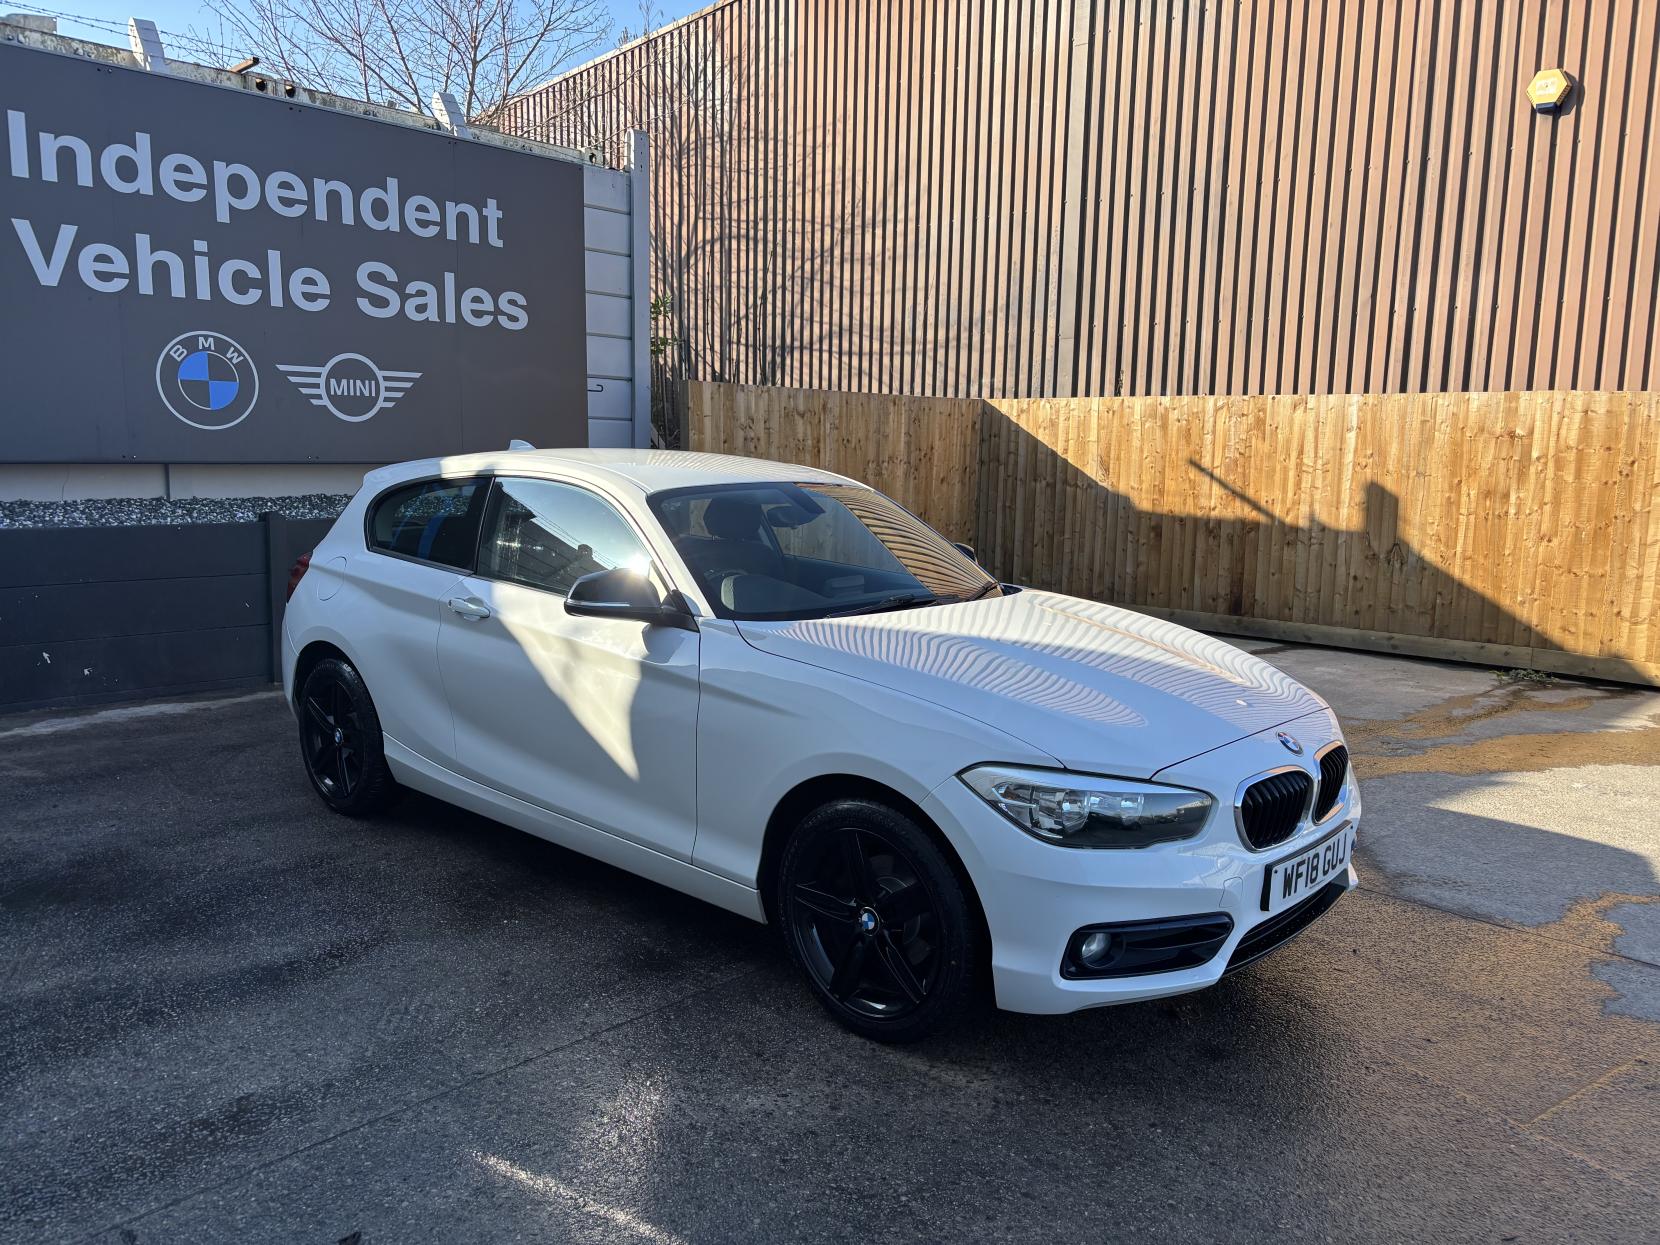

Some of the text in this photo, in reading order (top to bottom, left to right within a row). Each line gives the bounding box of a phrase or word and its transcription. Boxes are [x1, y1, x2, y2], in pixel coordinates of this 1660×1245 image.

[7, 109, 504, 248] Independent
[10, 217, 529, 331] Vehicle Sales
[169, 336, 243, 365] BMW
[329, 377, 377, 398] MINI
[1282, 833, 1347, 899] WF18 GUJ
